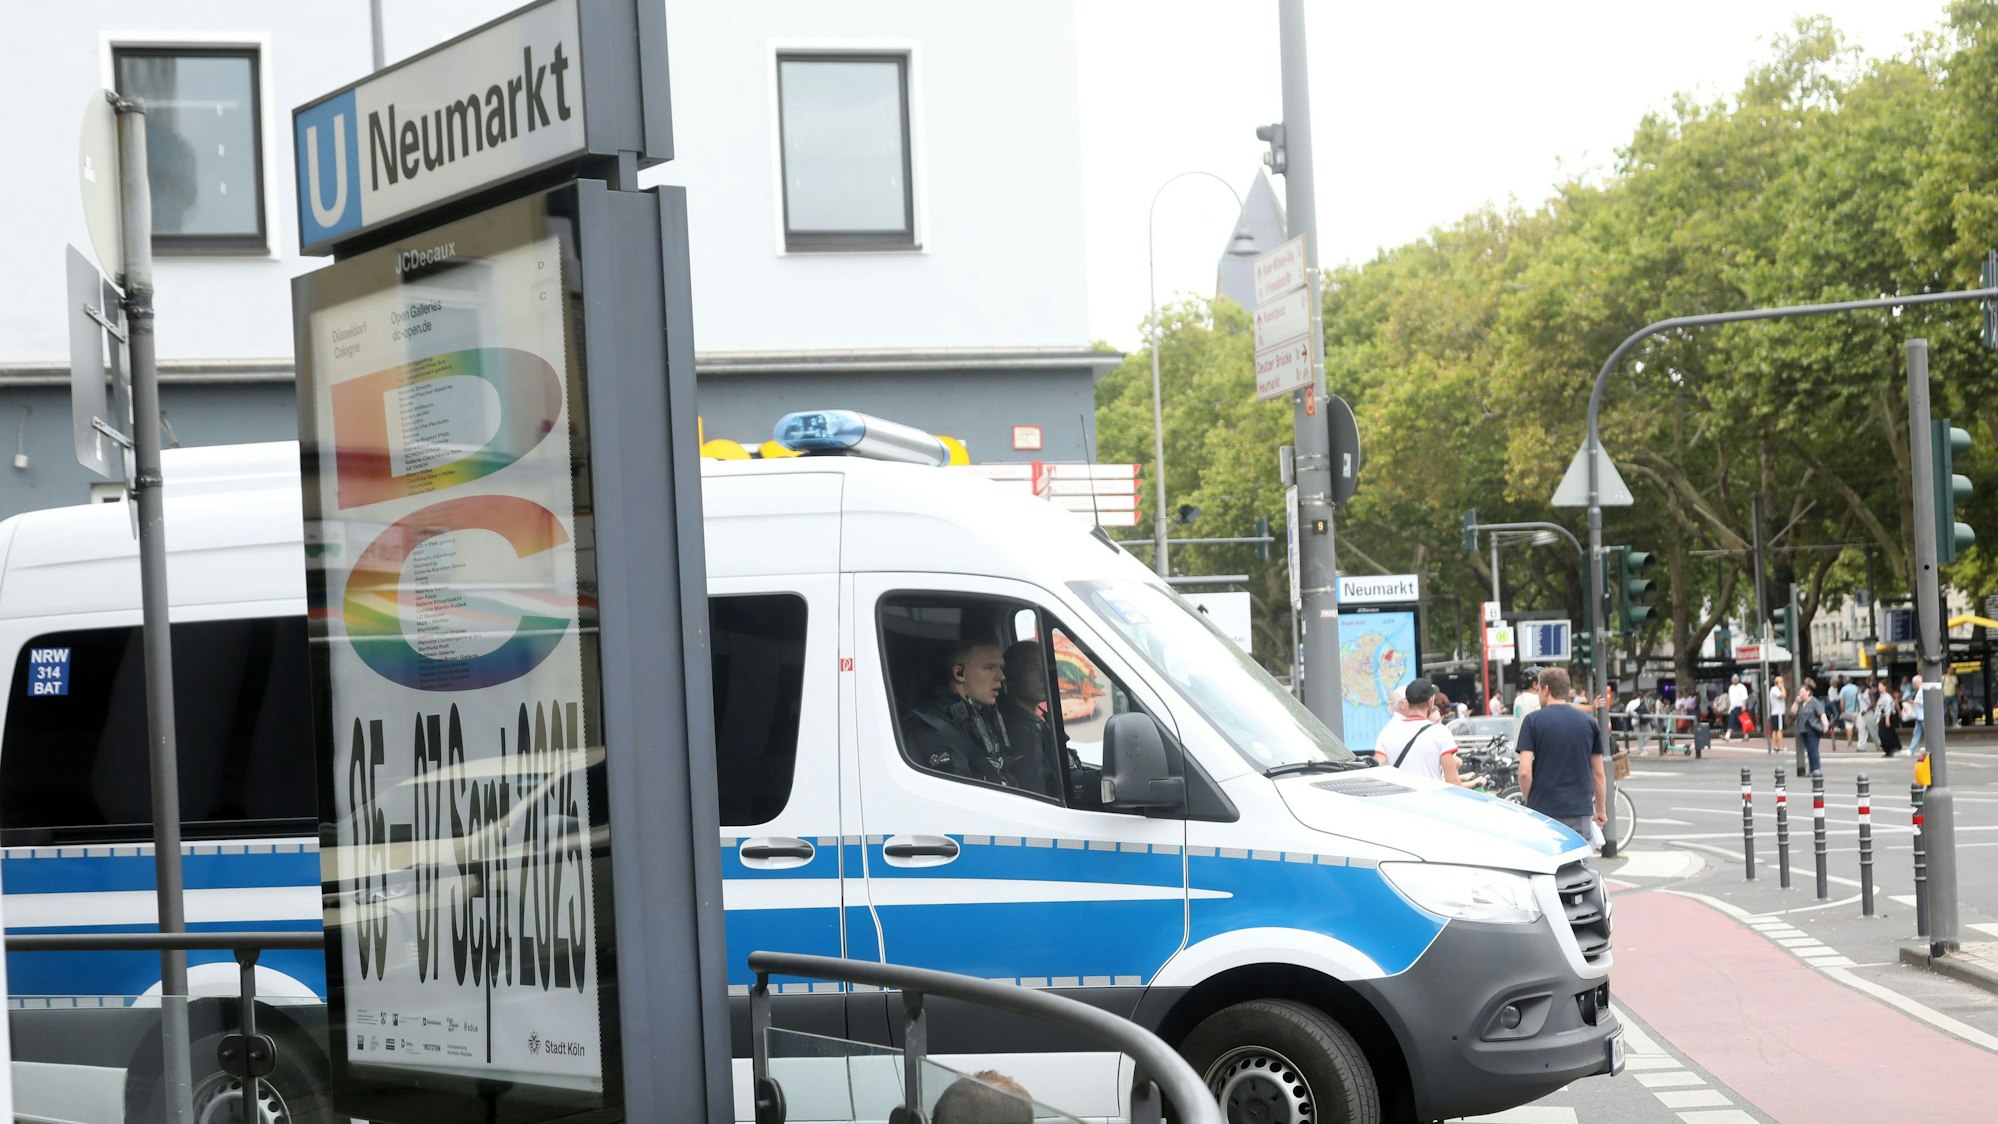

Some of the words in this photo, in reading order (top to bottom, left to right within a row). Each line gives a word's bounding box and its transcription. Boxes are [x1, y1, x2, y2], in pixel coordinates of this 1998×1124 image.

[306, 114, 348, 228] U
[368, 42, 571, 191] Neumarkt
[395, 240, 456, 274] JCDecaux
[391, 310, 409, 325] Open
[410, 301, 442, 318] Galleries
[332, 322, 367, 343] Düsseldorf
[392, 320, 432, 342] dc-open.de
[334, 343, 360, 359] Cologne
[1344, 580, 1414, 596] Neumarkt
[1490, 608, 1497, 618] B
[31, 648, 70, 664] NRW
[37, 666, 61, 679] 314
[34, 681, 62, 695] BAT
[517, 699, 586, 993] 2025
[545, 1040, 566, 1056] Stadt
[568, 1041, 585, 1057] Köln
